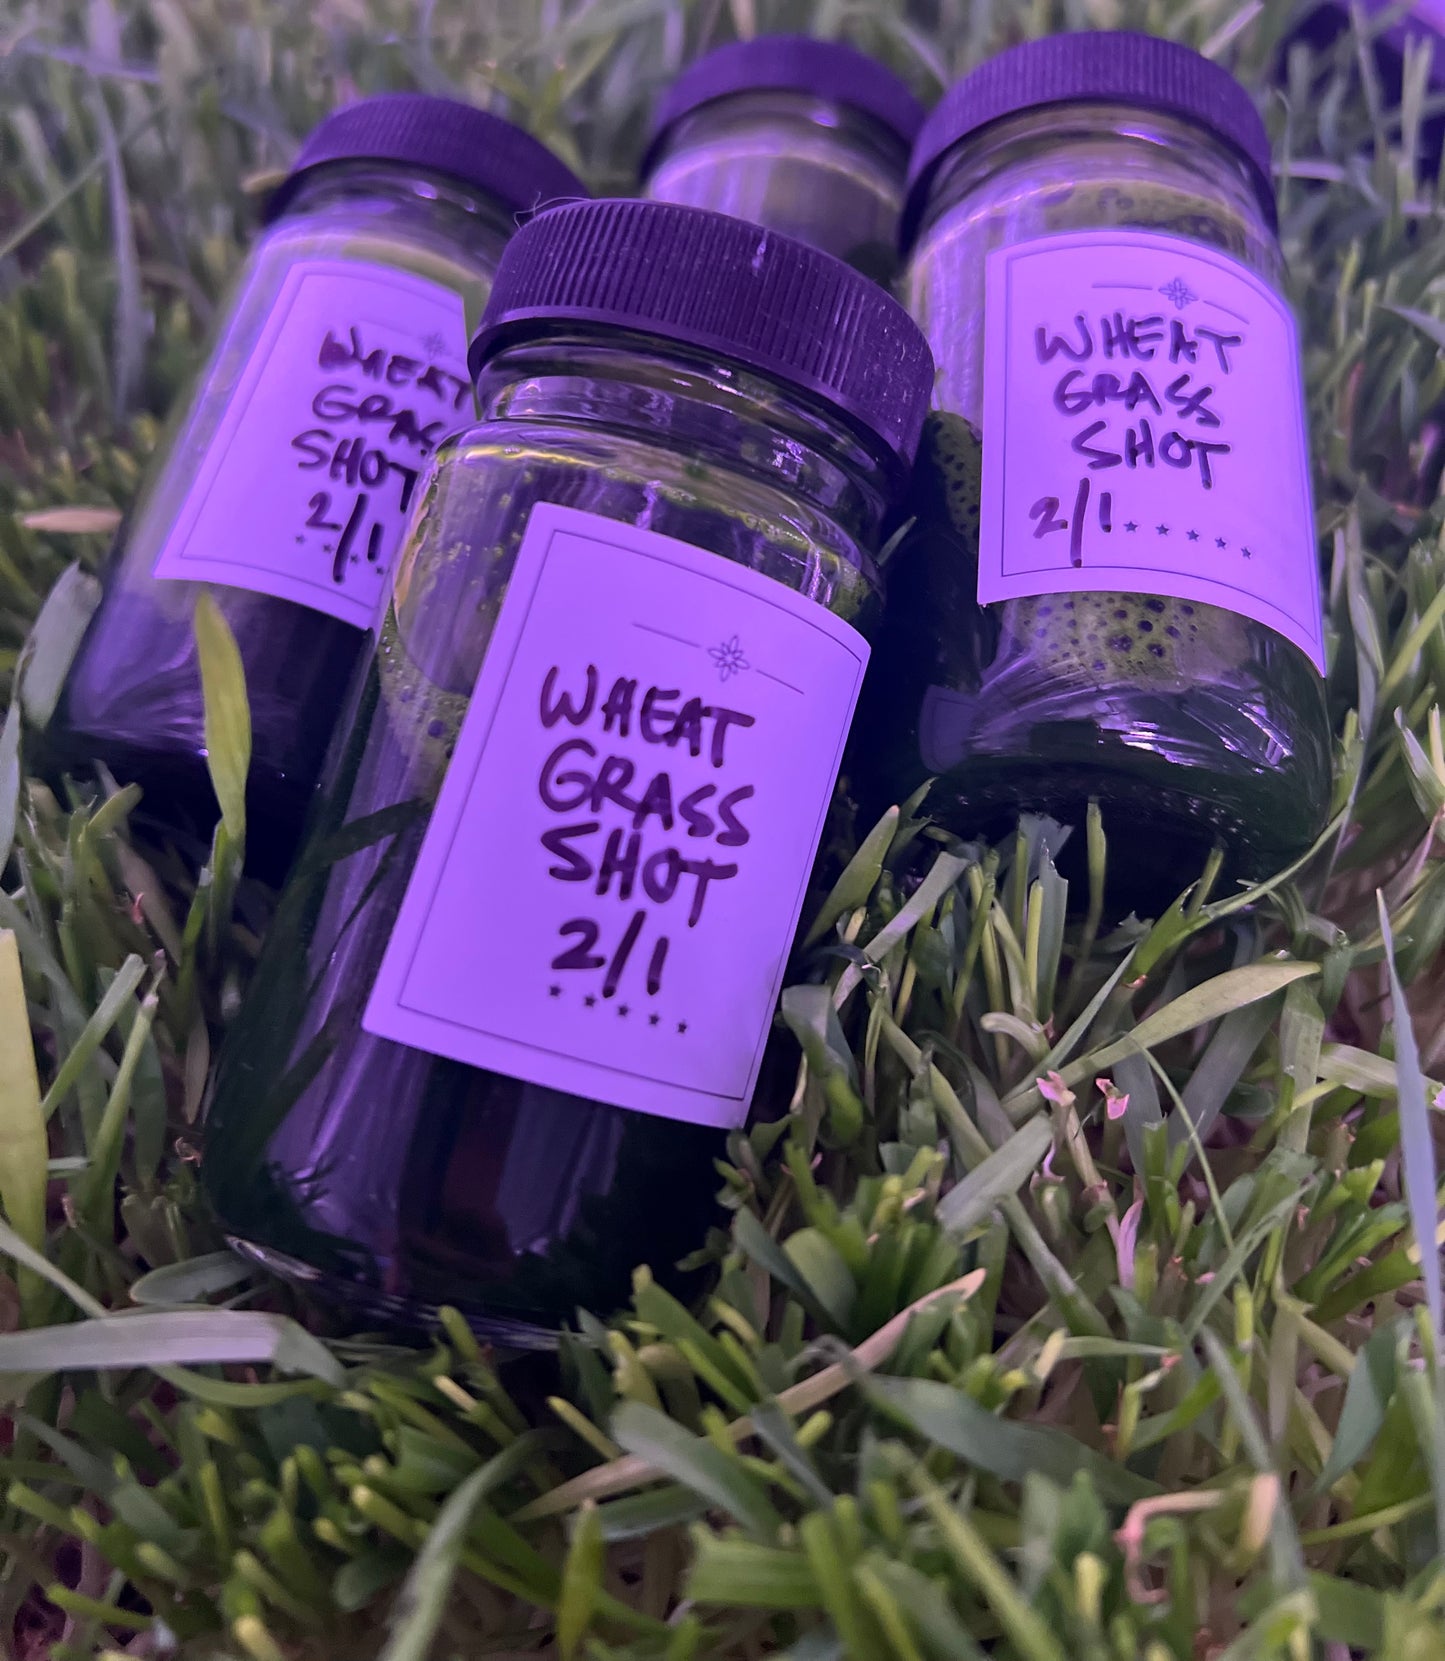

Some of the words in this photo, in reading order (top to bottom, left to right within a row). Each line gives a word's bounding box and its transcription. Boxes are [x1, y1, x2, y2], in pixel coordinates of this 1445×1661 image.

[1034, 313, 1242, 374] WHEAT
[312, 384, 446, 457] GRAS
[1053, 369, 1221, 428] GRASS
[291, 429, 420, 513] SHOT
[1070, 420, 1231, 490] SHOT
[305, 491, 382, 583] 2/1
[1028, 477, 1111, 568] 2/1
[540, 664, 755, 767] WHEAT
[539, 739, 754, 846] GRASS
[540, 822, 738, 928] SHOT
[551, 910, 669, 998] 2/1
